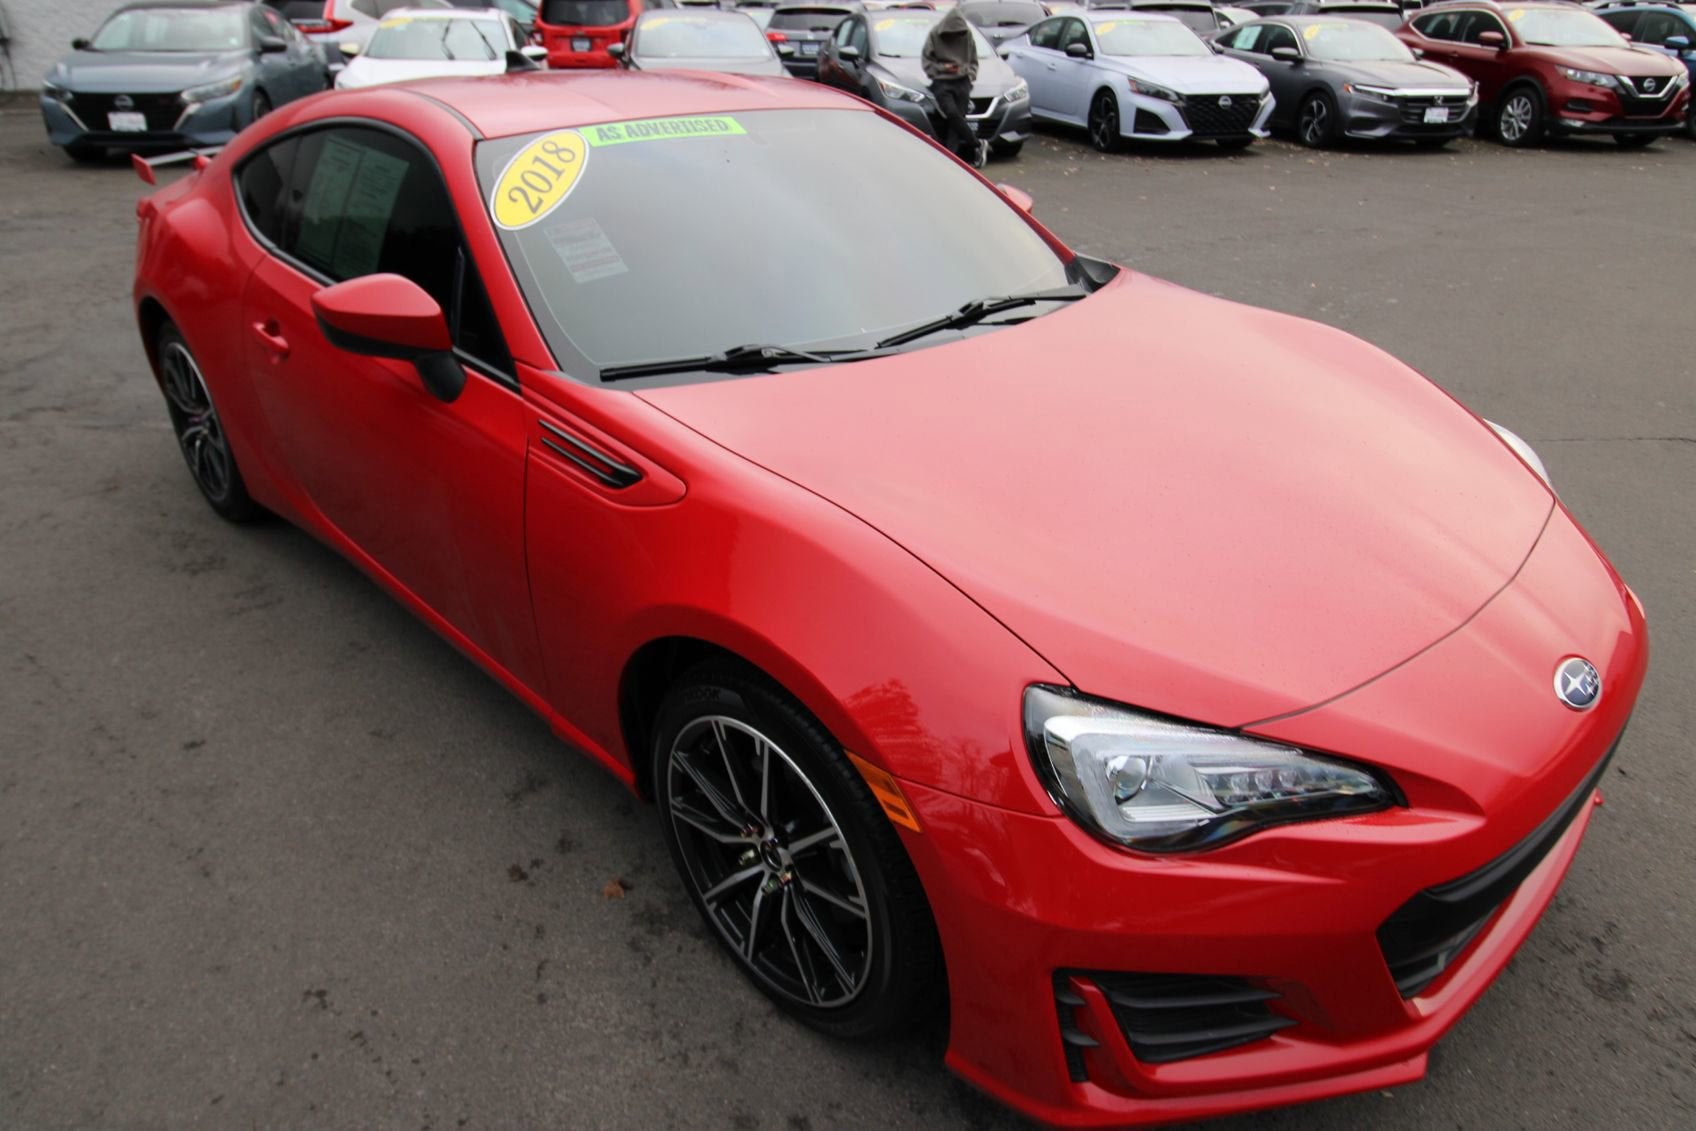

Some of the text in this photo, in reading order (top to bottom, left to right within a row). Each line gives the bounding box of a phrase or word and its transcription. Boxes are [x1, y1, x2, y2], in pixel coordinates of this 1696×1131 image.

[596, 119, 729, 142] AS ADVERTISED
[508, 140, 576, 214] 2018
